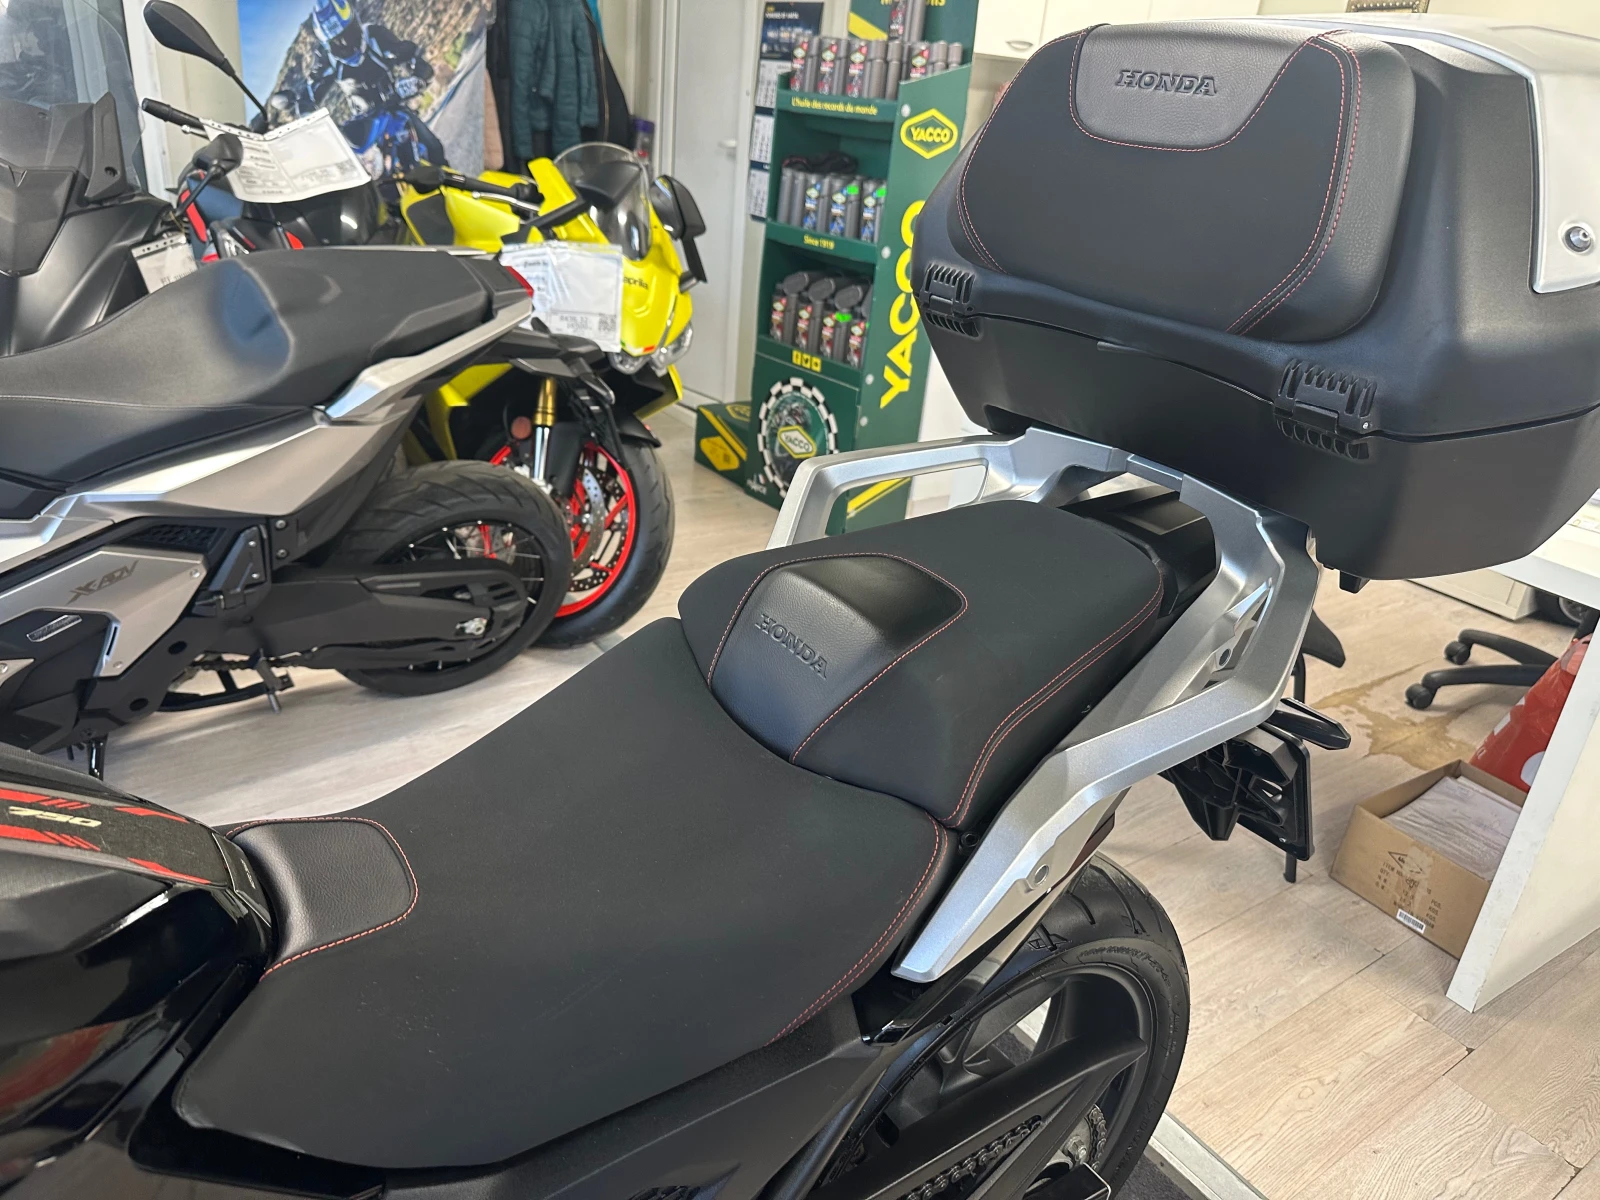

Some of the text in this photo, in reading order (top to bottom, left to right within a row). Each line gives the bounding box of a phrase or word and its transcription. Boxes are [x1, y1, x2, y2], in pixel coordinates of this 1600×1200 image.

[1115, 69, 1218, 96] HONDA
[823, 100, 845, 112] records
[855, 104, 878, 116] monde
[911, 126, 951, 143] YACCO
[803, 234, 819, 247] Since
[784, 433, 811, 453] YACCO
[755, 613, 828, 680] HONDA
[8, 806, 102, 828] 750
